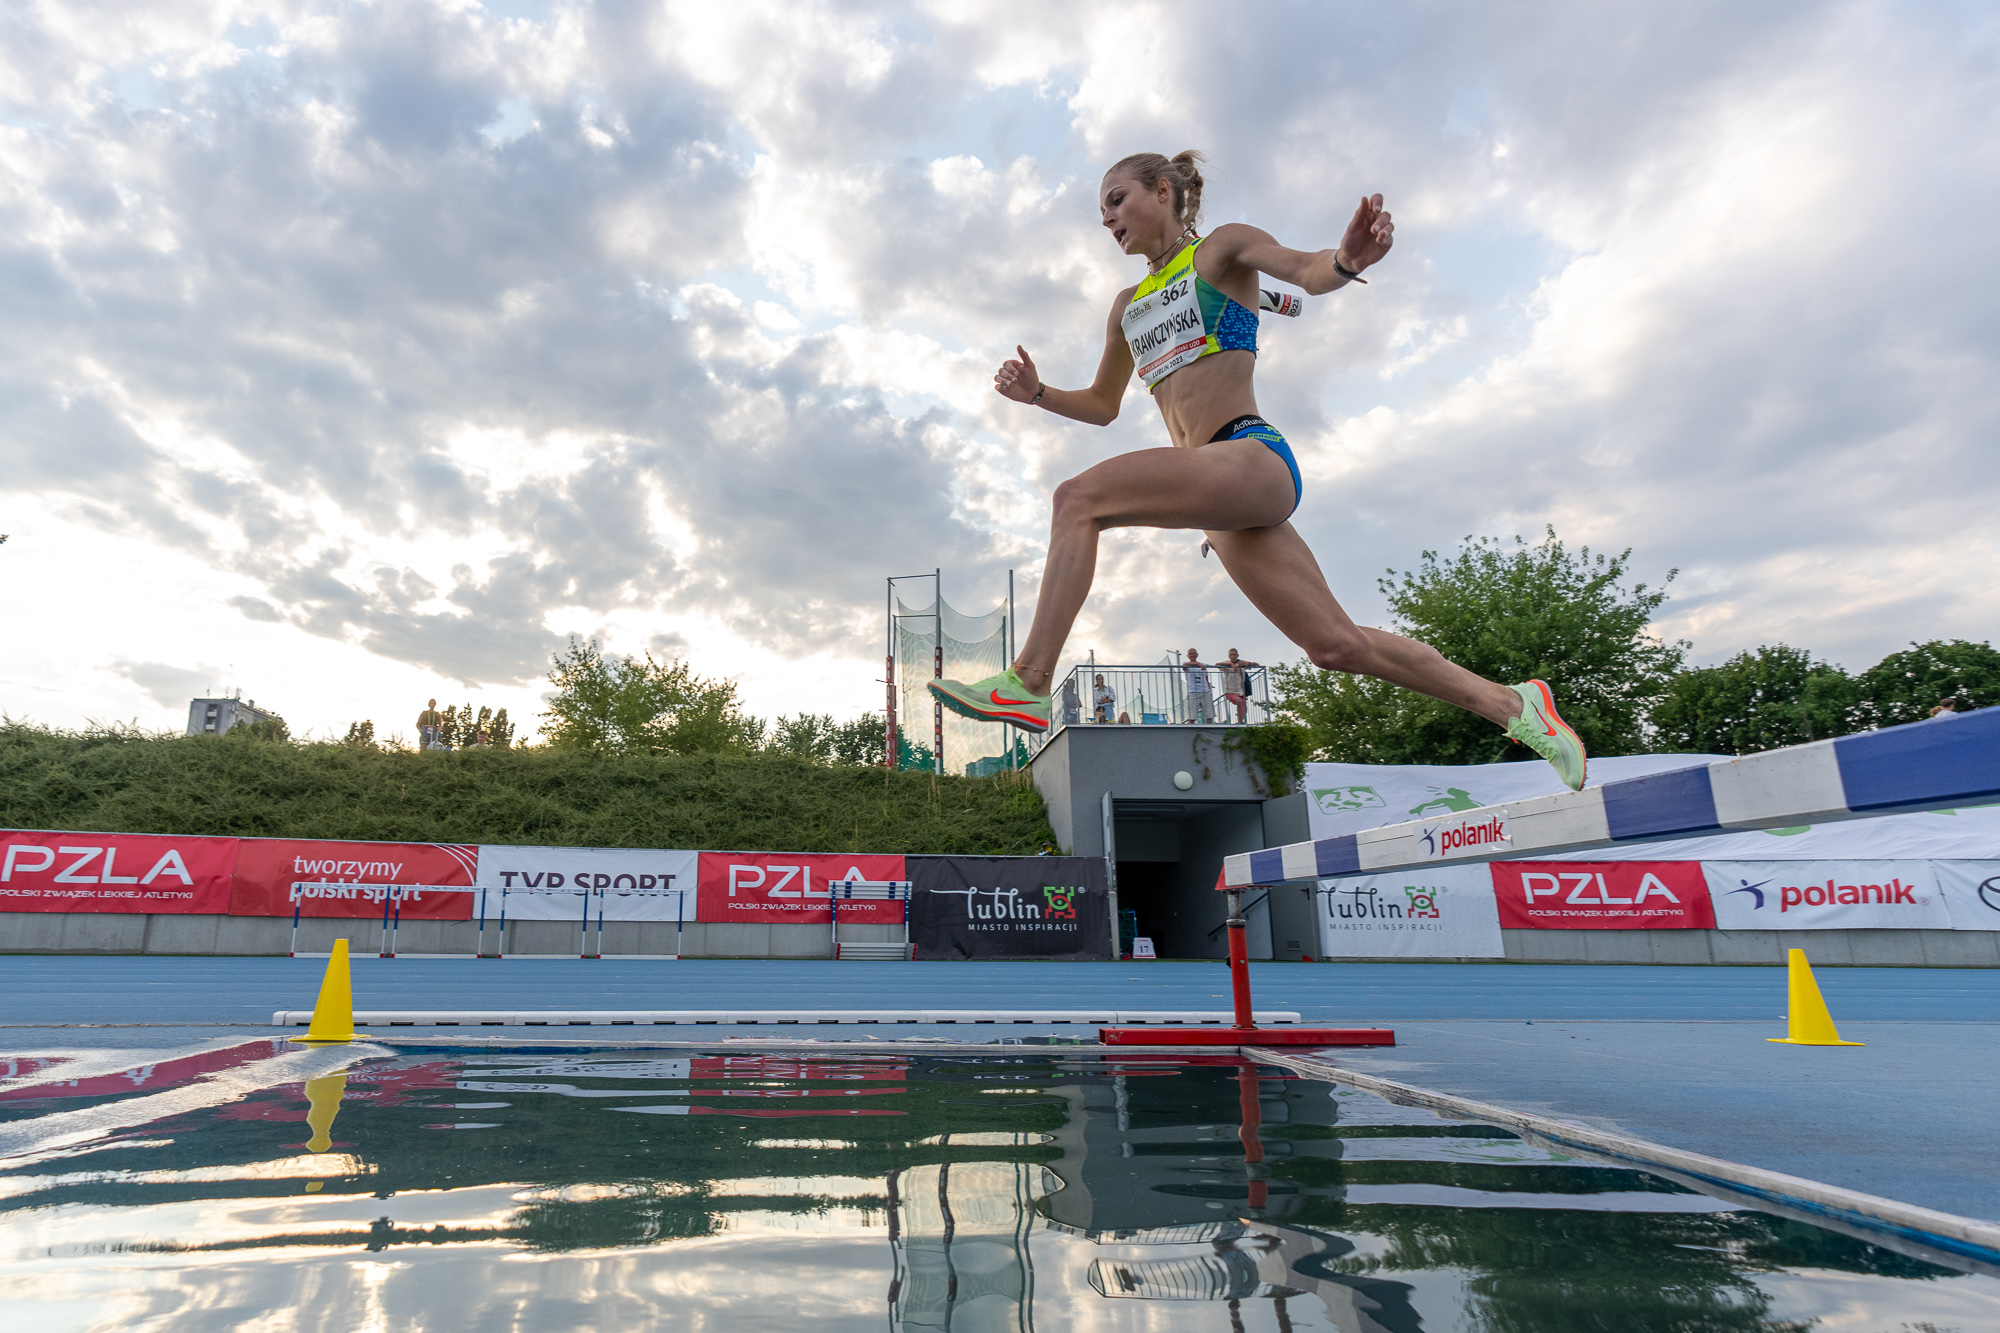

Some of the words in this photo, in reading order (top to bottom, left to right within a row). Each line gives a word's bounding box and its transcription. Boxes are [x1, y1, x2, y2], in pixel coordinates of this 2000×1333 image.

[1161, 280, 1188, 306] 362
[1288, 299, 1299, 317] 2023
[1130, 308, 1200, 359] KRAWCZYŃSKA
[1173, 344, 1188, 353] Polski
[1188, 339, 1200, 348] U20
[1151, 364, 1169, 378] LUBLIN
[1168, 355, 1183, 368] 2023
[1, 845, 194, 885] PZLA
[294, 855, 403, 880] tworzymy
[43, 890, 96, 898] ZWIĄZEK
[500, 871, 565, 895] TVP
[574, 873, 676, 896] SPORT
[1521, 872, 1680, 904] PZLA
[1780, 878, 1917, 913] polanik
[1379, 923, 1442, 931] INSPIRACJI
